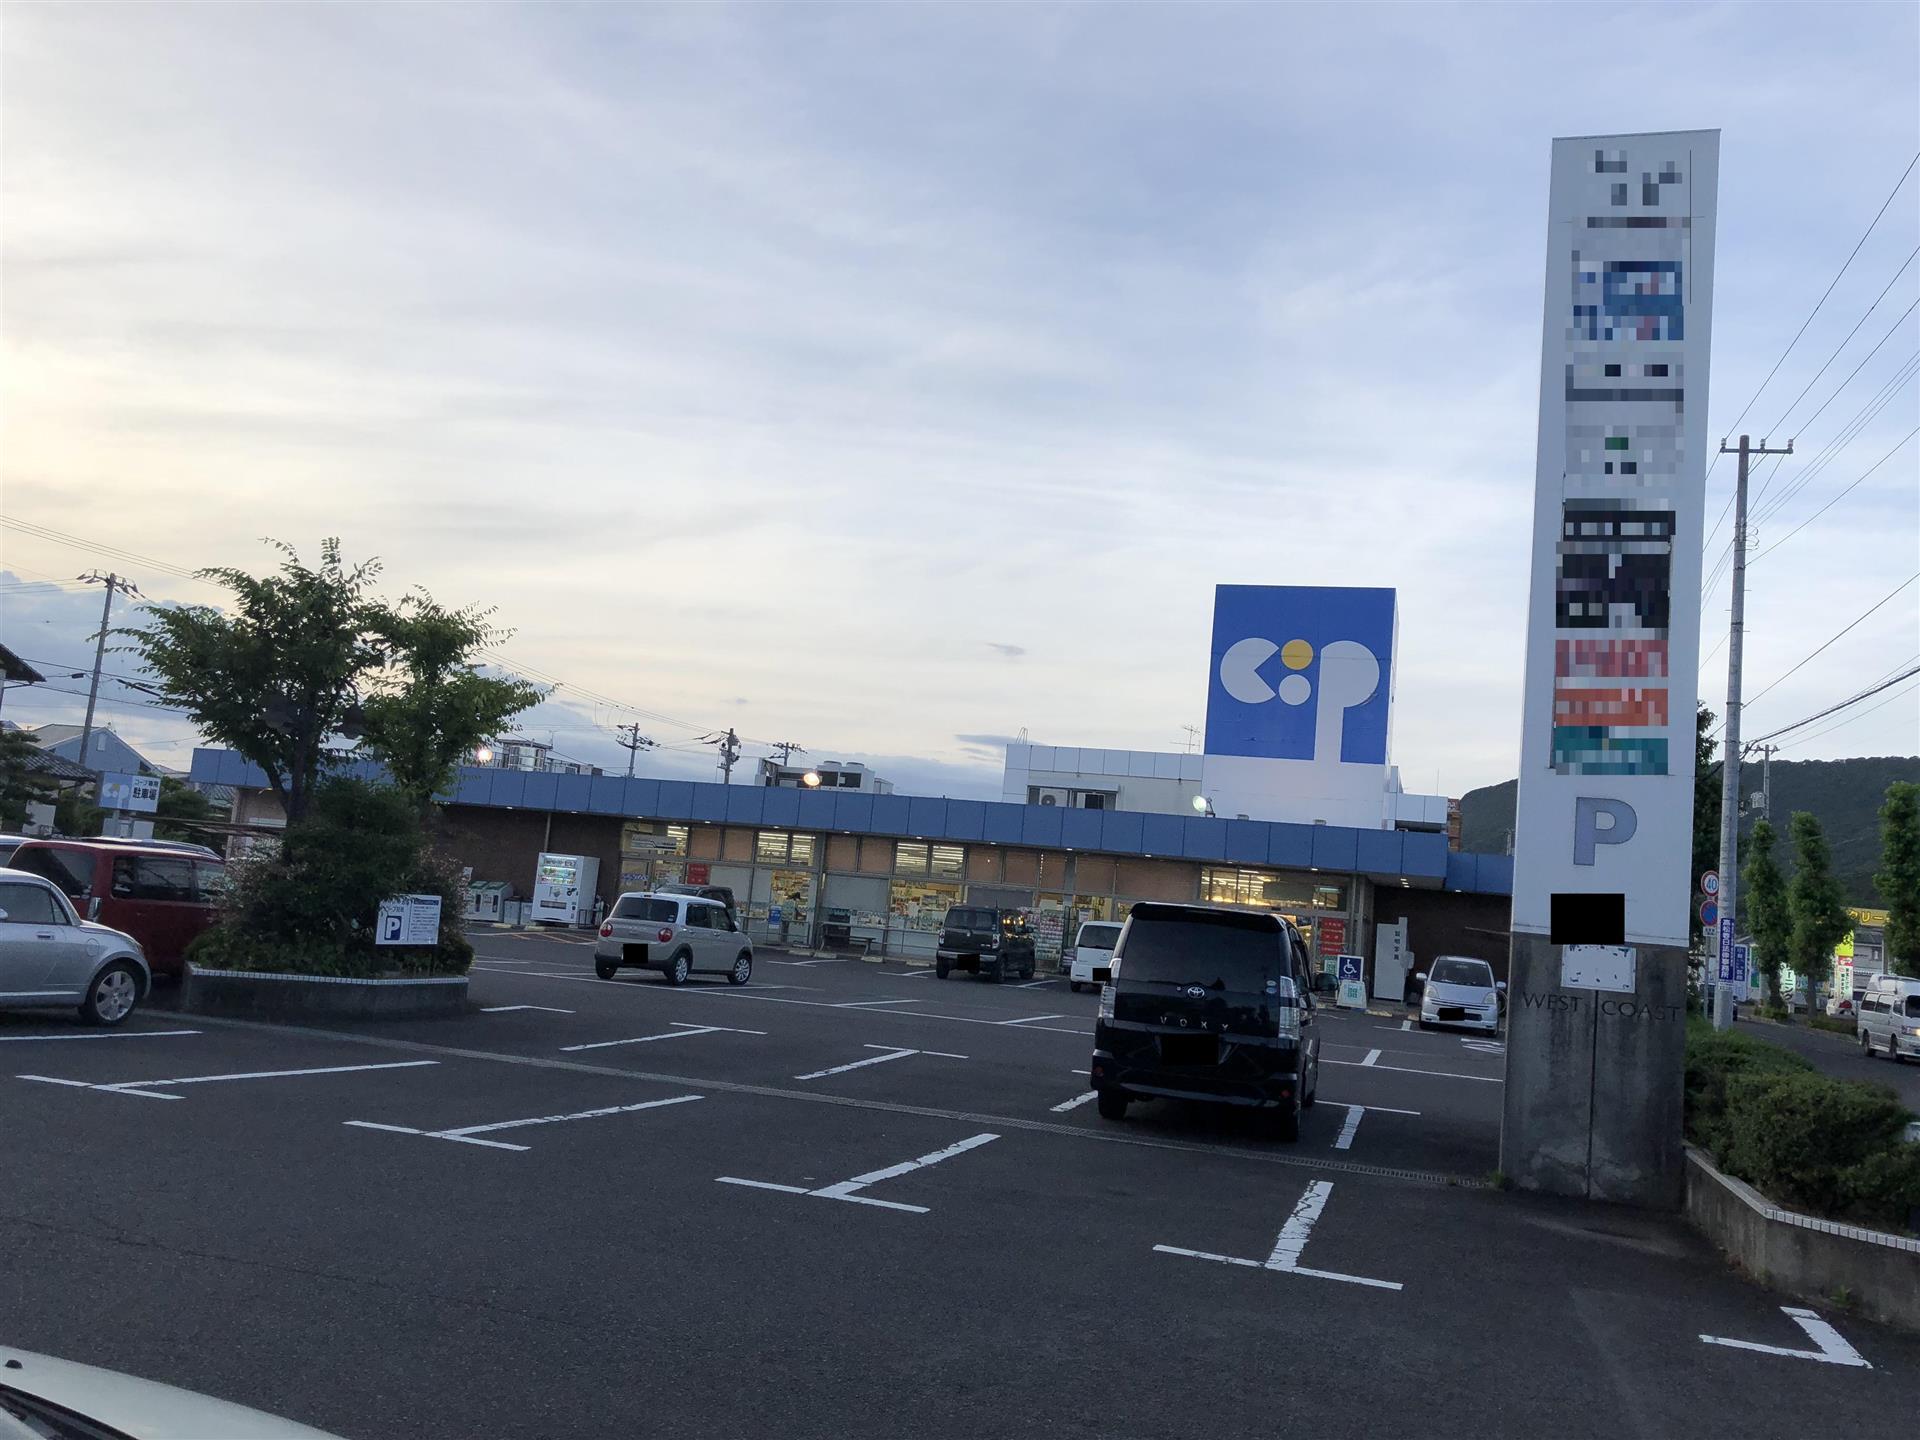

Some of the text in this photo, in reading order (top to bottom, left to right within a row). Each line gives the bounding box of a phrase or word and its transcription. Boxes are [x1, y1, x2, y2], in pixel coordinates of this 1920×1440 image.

[132, 787, 157, 800] 駐車場
[1573, 797, 1637, 866] P
[1707, 878, 1717, 890] 40
[1523, 991, 1681, 1022] WEST COAST
[1160, 1016, 1229, 1031] VOXY
